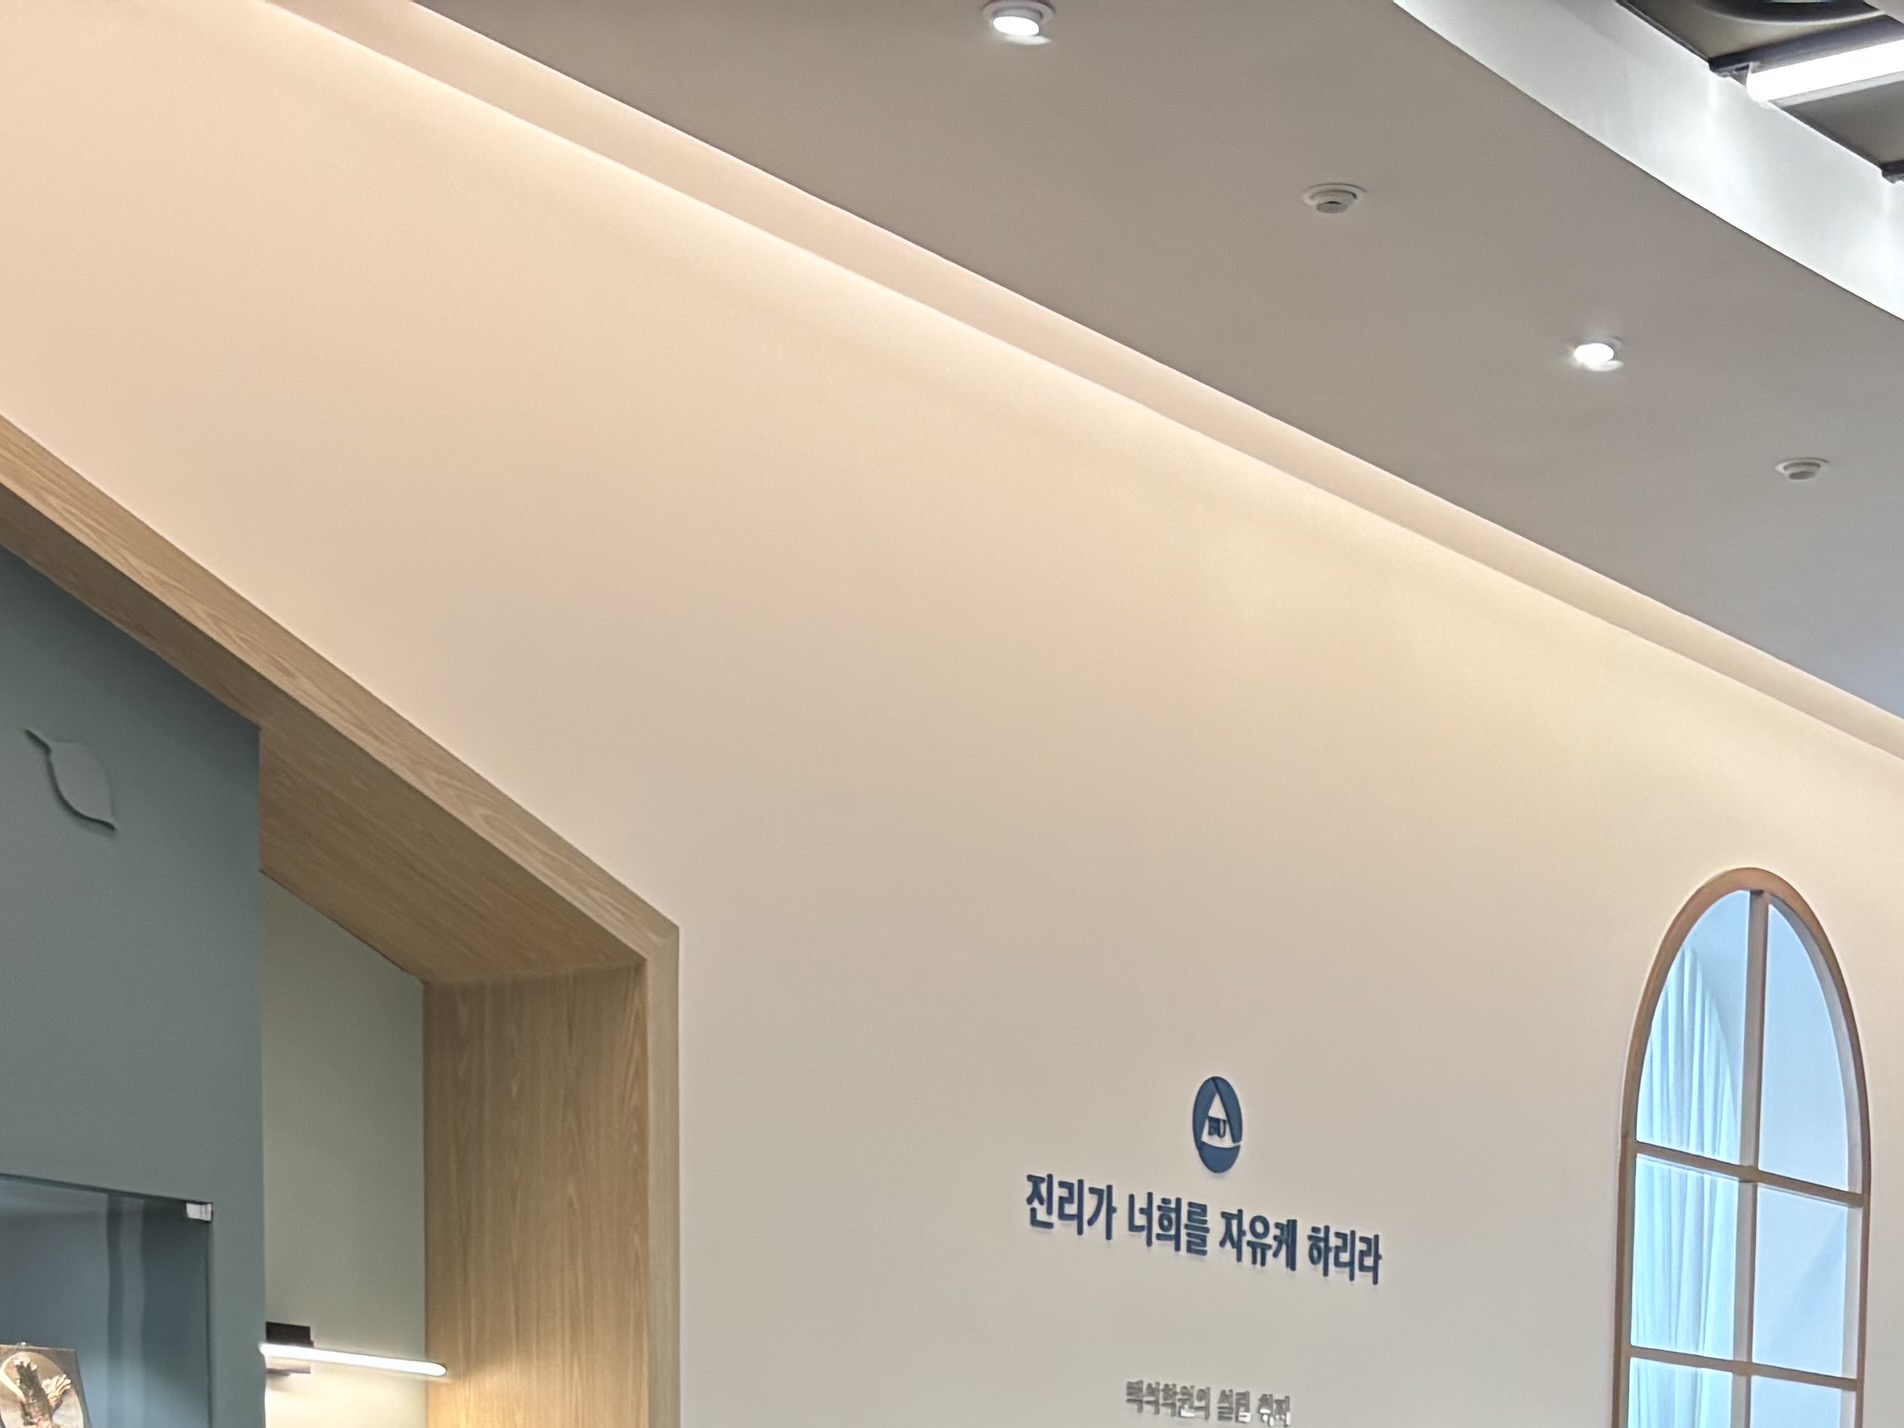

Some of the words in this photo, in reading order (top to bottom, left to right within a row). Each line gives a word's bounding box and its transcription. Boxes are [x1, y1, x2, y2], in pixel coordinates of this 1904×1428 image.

[1026, 1173, 1117, 1241] 진리가
[1128, 1191, 1211, 1257] 너희를
[1219, 1208, 1298, 1272] 자유케
[1307, 1224, 1383, 1286] 하리라
[1126, 1380, 1211, 1421] 백석학원의
[1217, 1389, 1251, 1424] 설립
